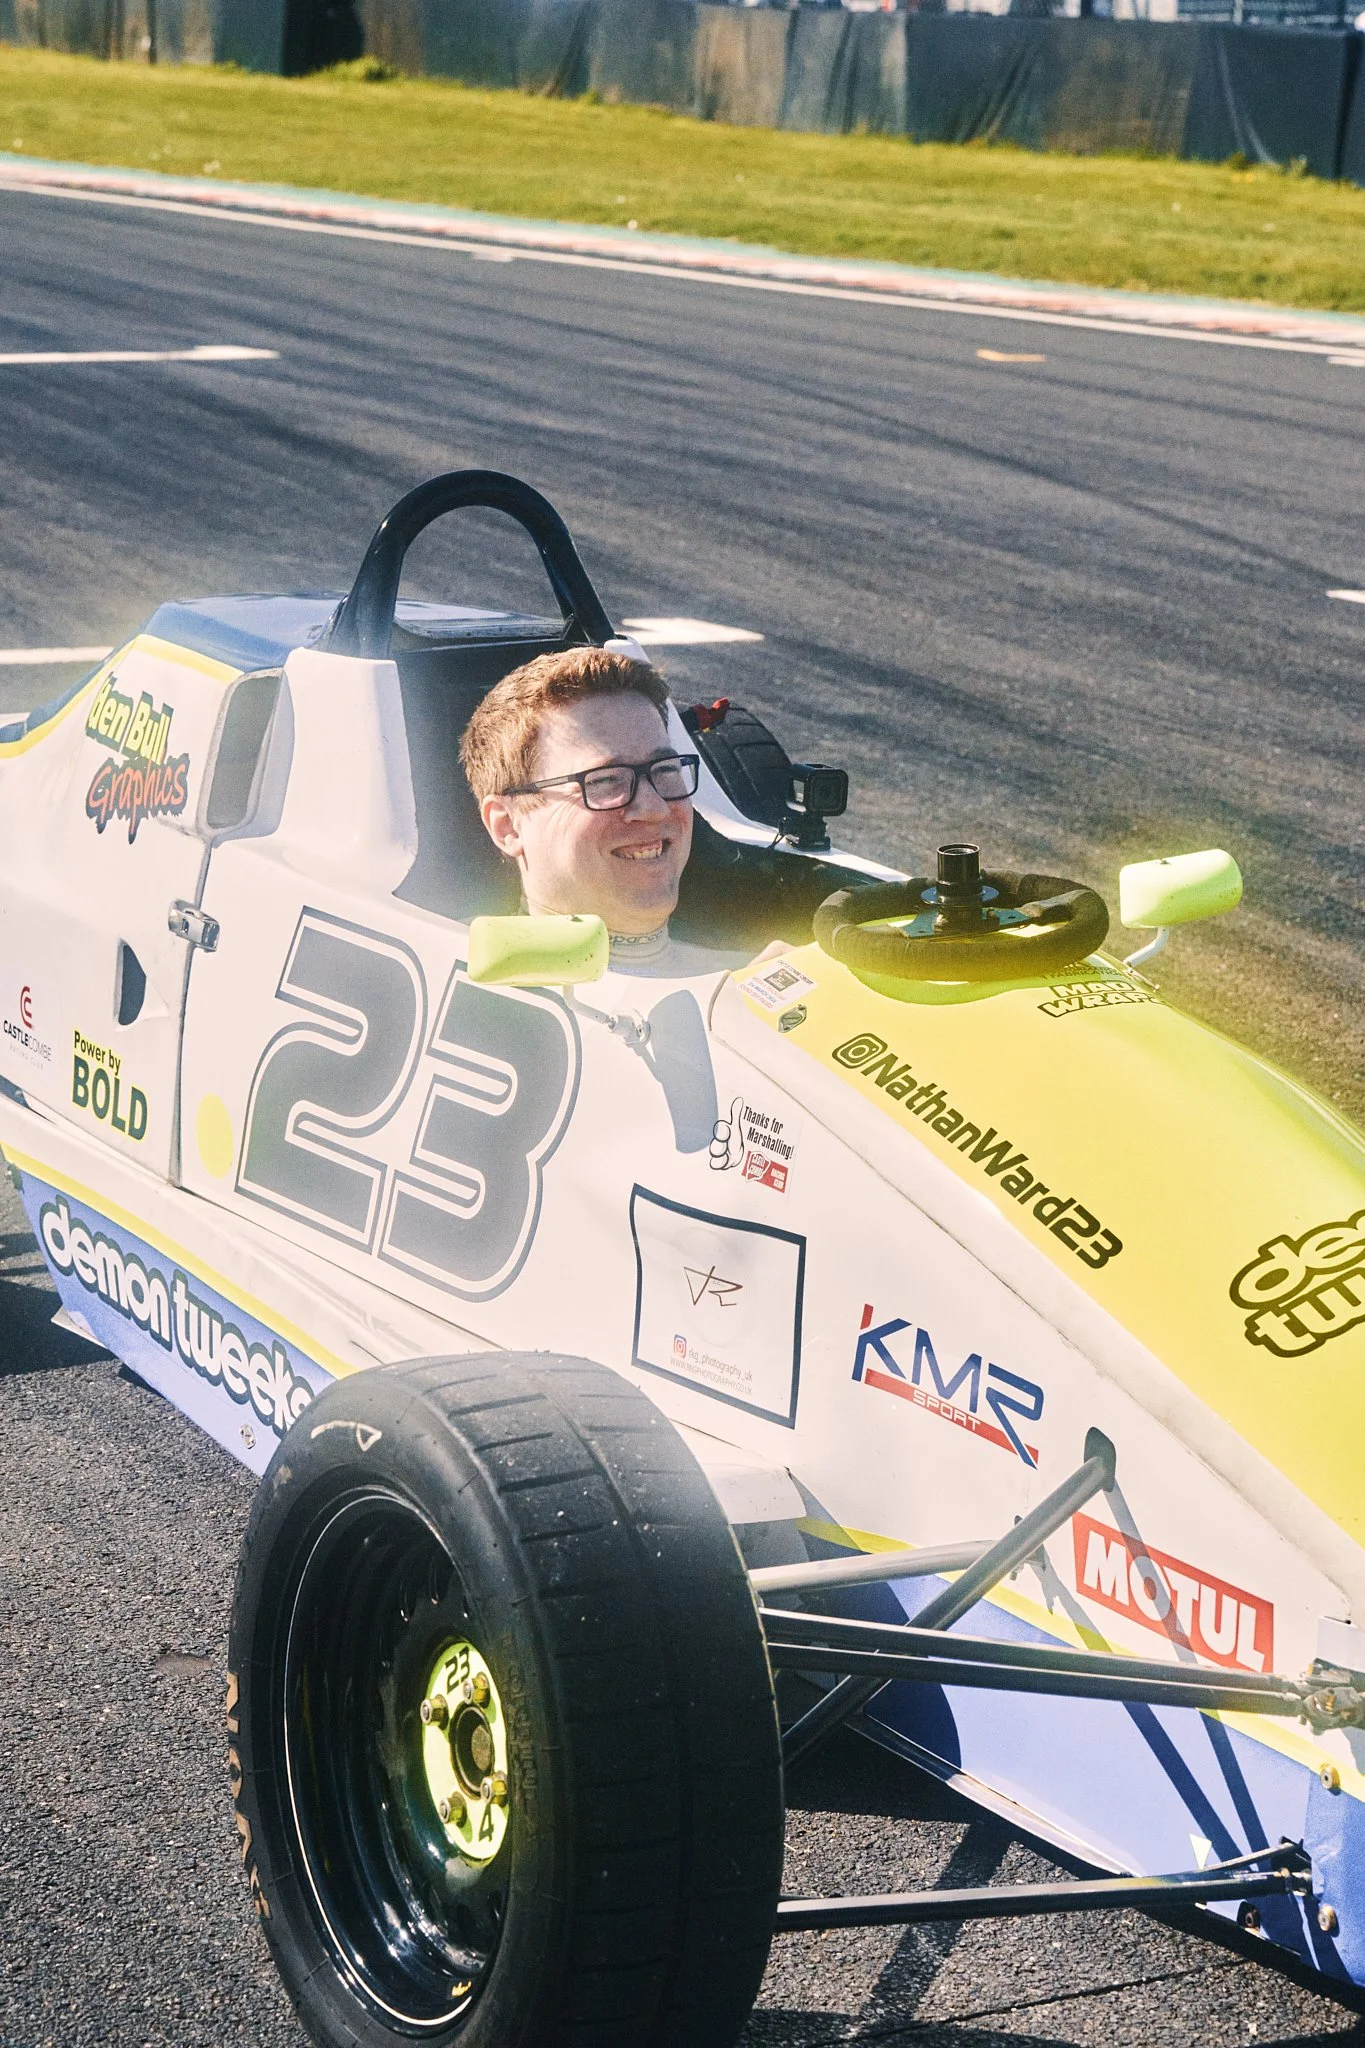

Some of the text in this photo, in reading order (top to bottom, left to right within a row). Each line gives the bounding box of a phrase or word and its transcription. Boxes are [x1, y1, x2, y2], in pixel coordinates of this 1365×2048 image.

[124, 694, 172, 767] Bull
[88, 758, 187, 836] Graphics
[1037, 990, 1166, 1018] WRAP
[1048, 979, 1137, 998] MAD
[74, 1030, 121, 1076] Power by
[72, 1054, 148, 1141] BOLD
[234, 904, 583, 1303] 23
[743, 1105, 784, 1135] Thanks for
[747, 1126, 795, 1160] Marshalling!
[860, 1052, 1123, 1270] NathanWard23
[40, 1197, 172, 1350] demon
[1229, 1208, 1365, 1311] de
[851, 1303, 1045, 1470] KMR
[912, 1389, 981, 1432] SPORT
[1083, 1530, 1265, 1673] MOTUL
[445, 1646, 471, 1695] 23
[478, 1803, 495, 1842] 4
